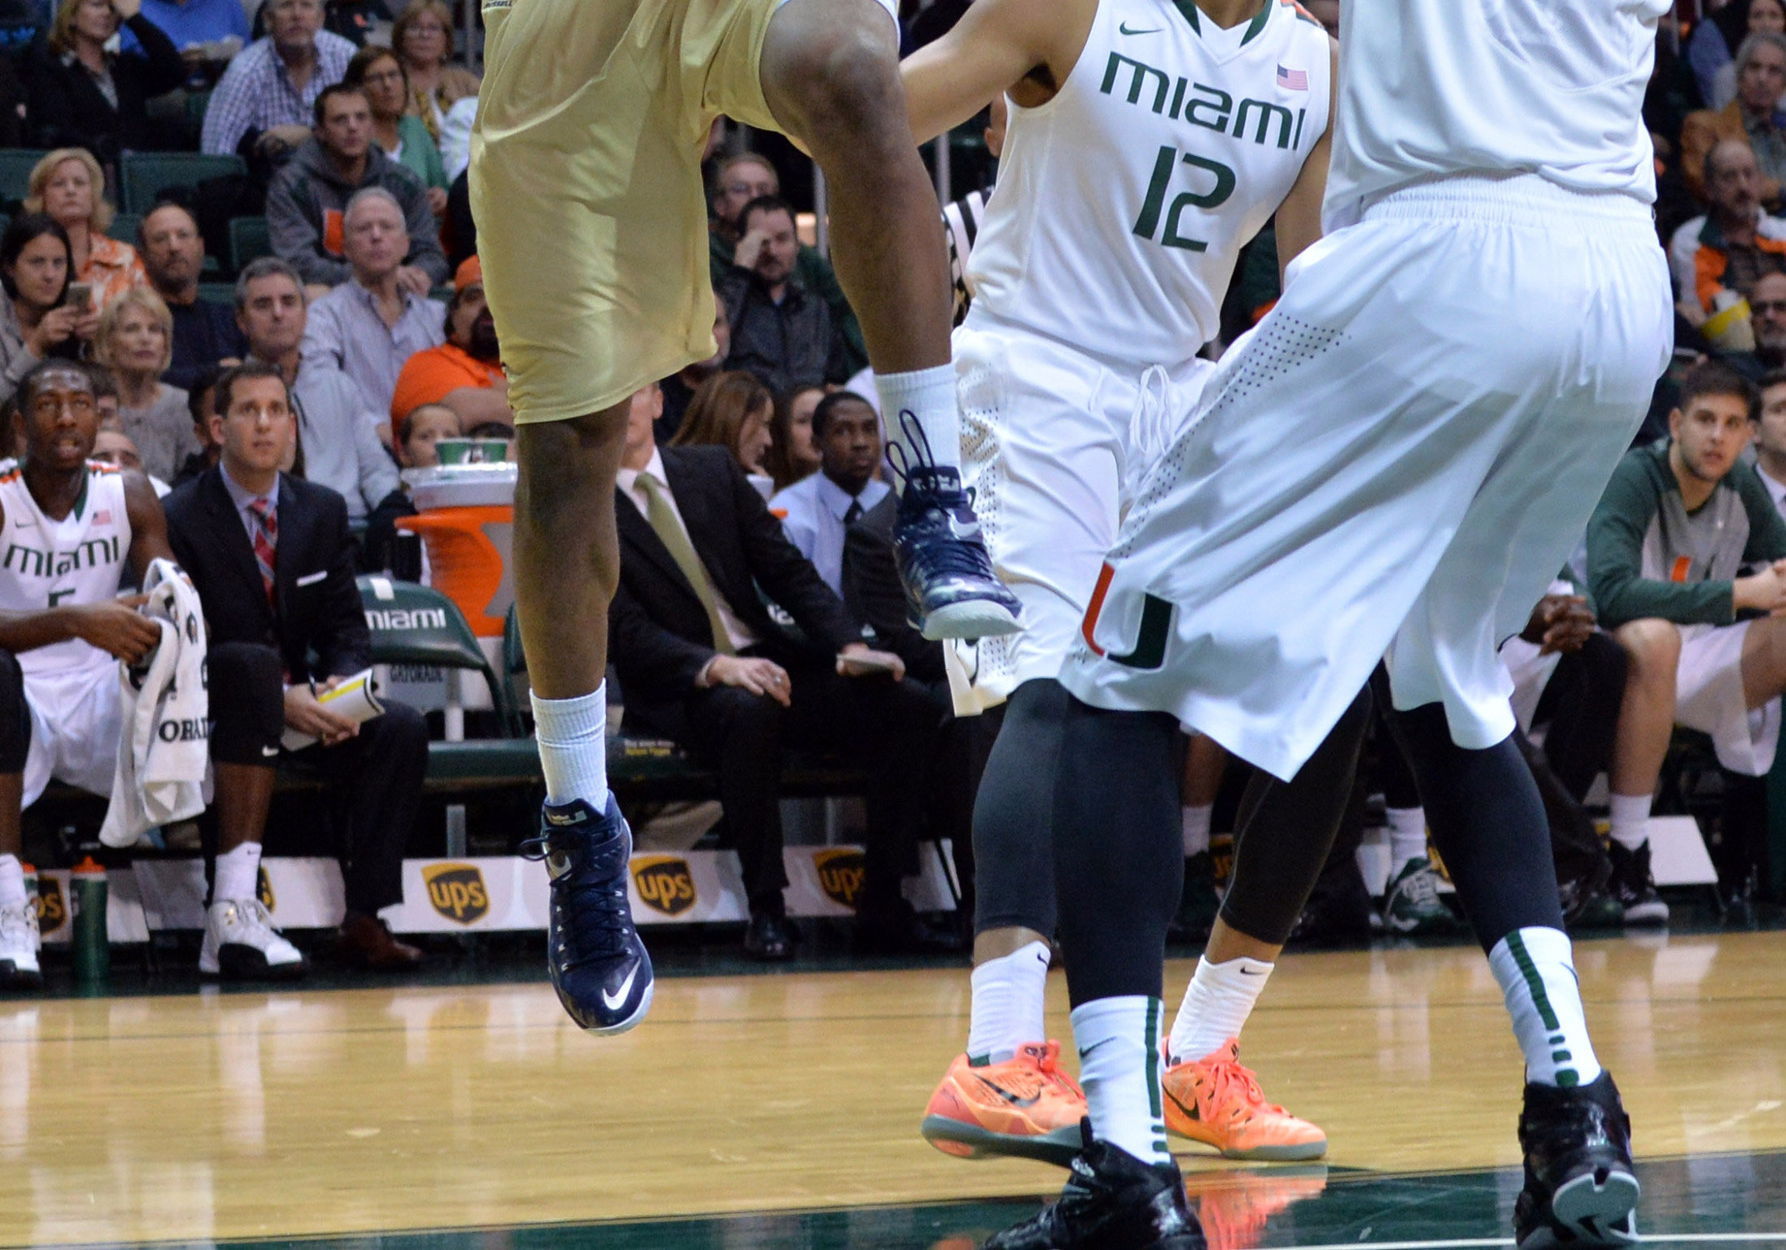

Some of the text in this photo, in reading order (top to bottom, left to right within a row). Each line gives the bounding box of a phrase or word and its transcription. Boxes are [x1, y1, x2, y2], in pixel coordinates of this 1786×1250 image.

[1132, 145, 1236, 253] 12
[1082, 560, 1172, 670] U
[429, 881, 487, 917] ups
[636, 872, 695, 908] ups
